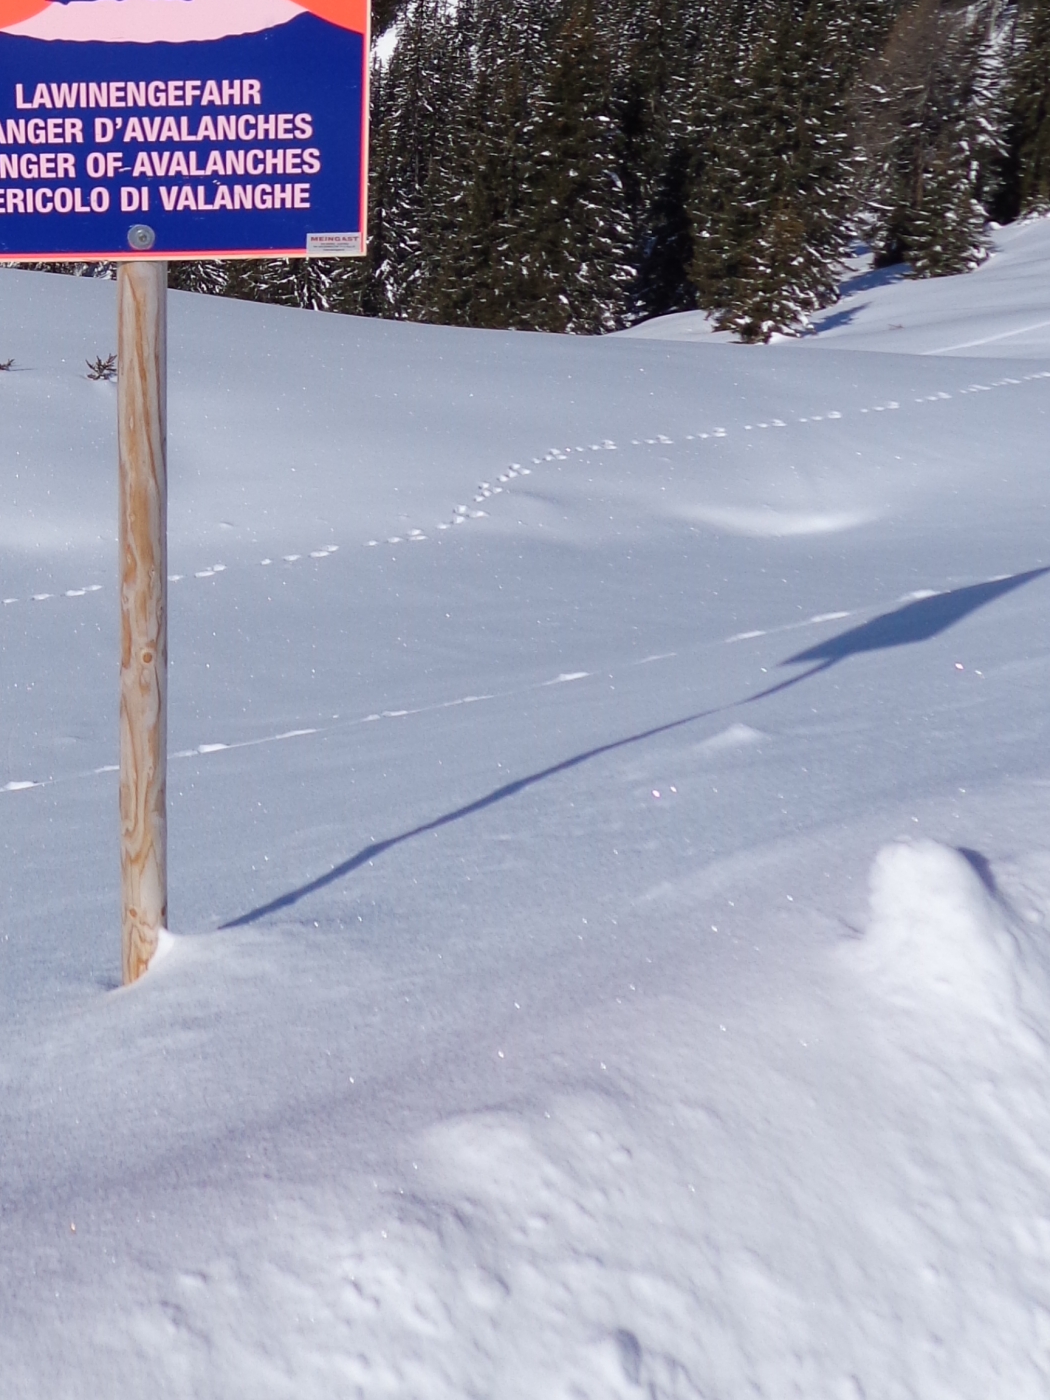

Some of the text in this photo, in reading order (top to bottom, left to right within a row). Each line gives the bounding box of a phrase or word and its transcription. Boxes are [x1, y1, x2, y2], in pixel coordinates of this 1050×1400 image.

[15, 79, 261, 109] LAWINENGEFAHR
[94, 113, 313, 143] D'AVALANCHES
[86, 151, 123, 178] OF
[132, 147, 321, 177] AVALANCHES
[120, 186, 149, 212] DI
[158, 183, 311, 211] VALANGHE
